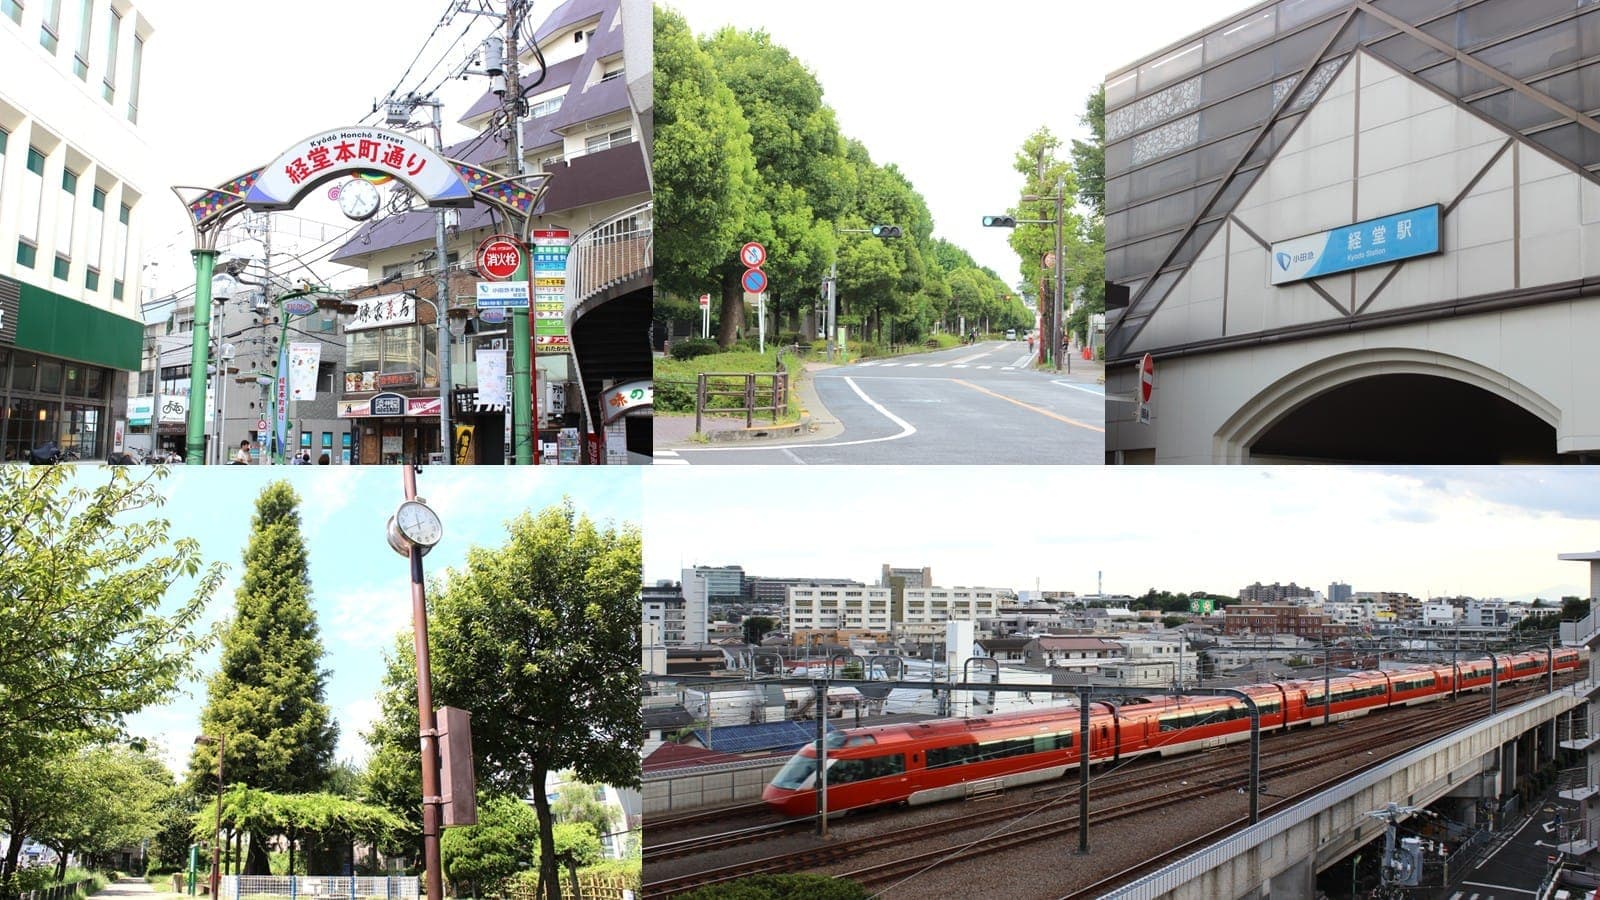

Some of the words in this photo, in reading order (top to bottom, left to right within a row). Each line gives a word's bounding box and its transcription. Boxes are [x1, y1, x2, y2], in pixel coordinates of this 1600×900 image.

[377, 133, 404, 145] Street
[285, 139, 426, 184] 経堂本町通り
[1347, 219, 1412, 250] 経堂駅
[487, 252, 517, 266] 消火栓
[1293, 251, 1314, 264] 小田急
[1348, 253, 1365, 261] Kyodo
[1366, 248, 1386, 259] Station
